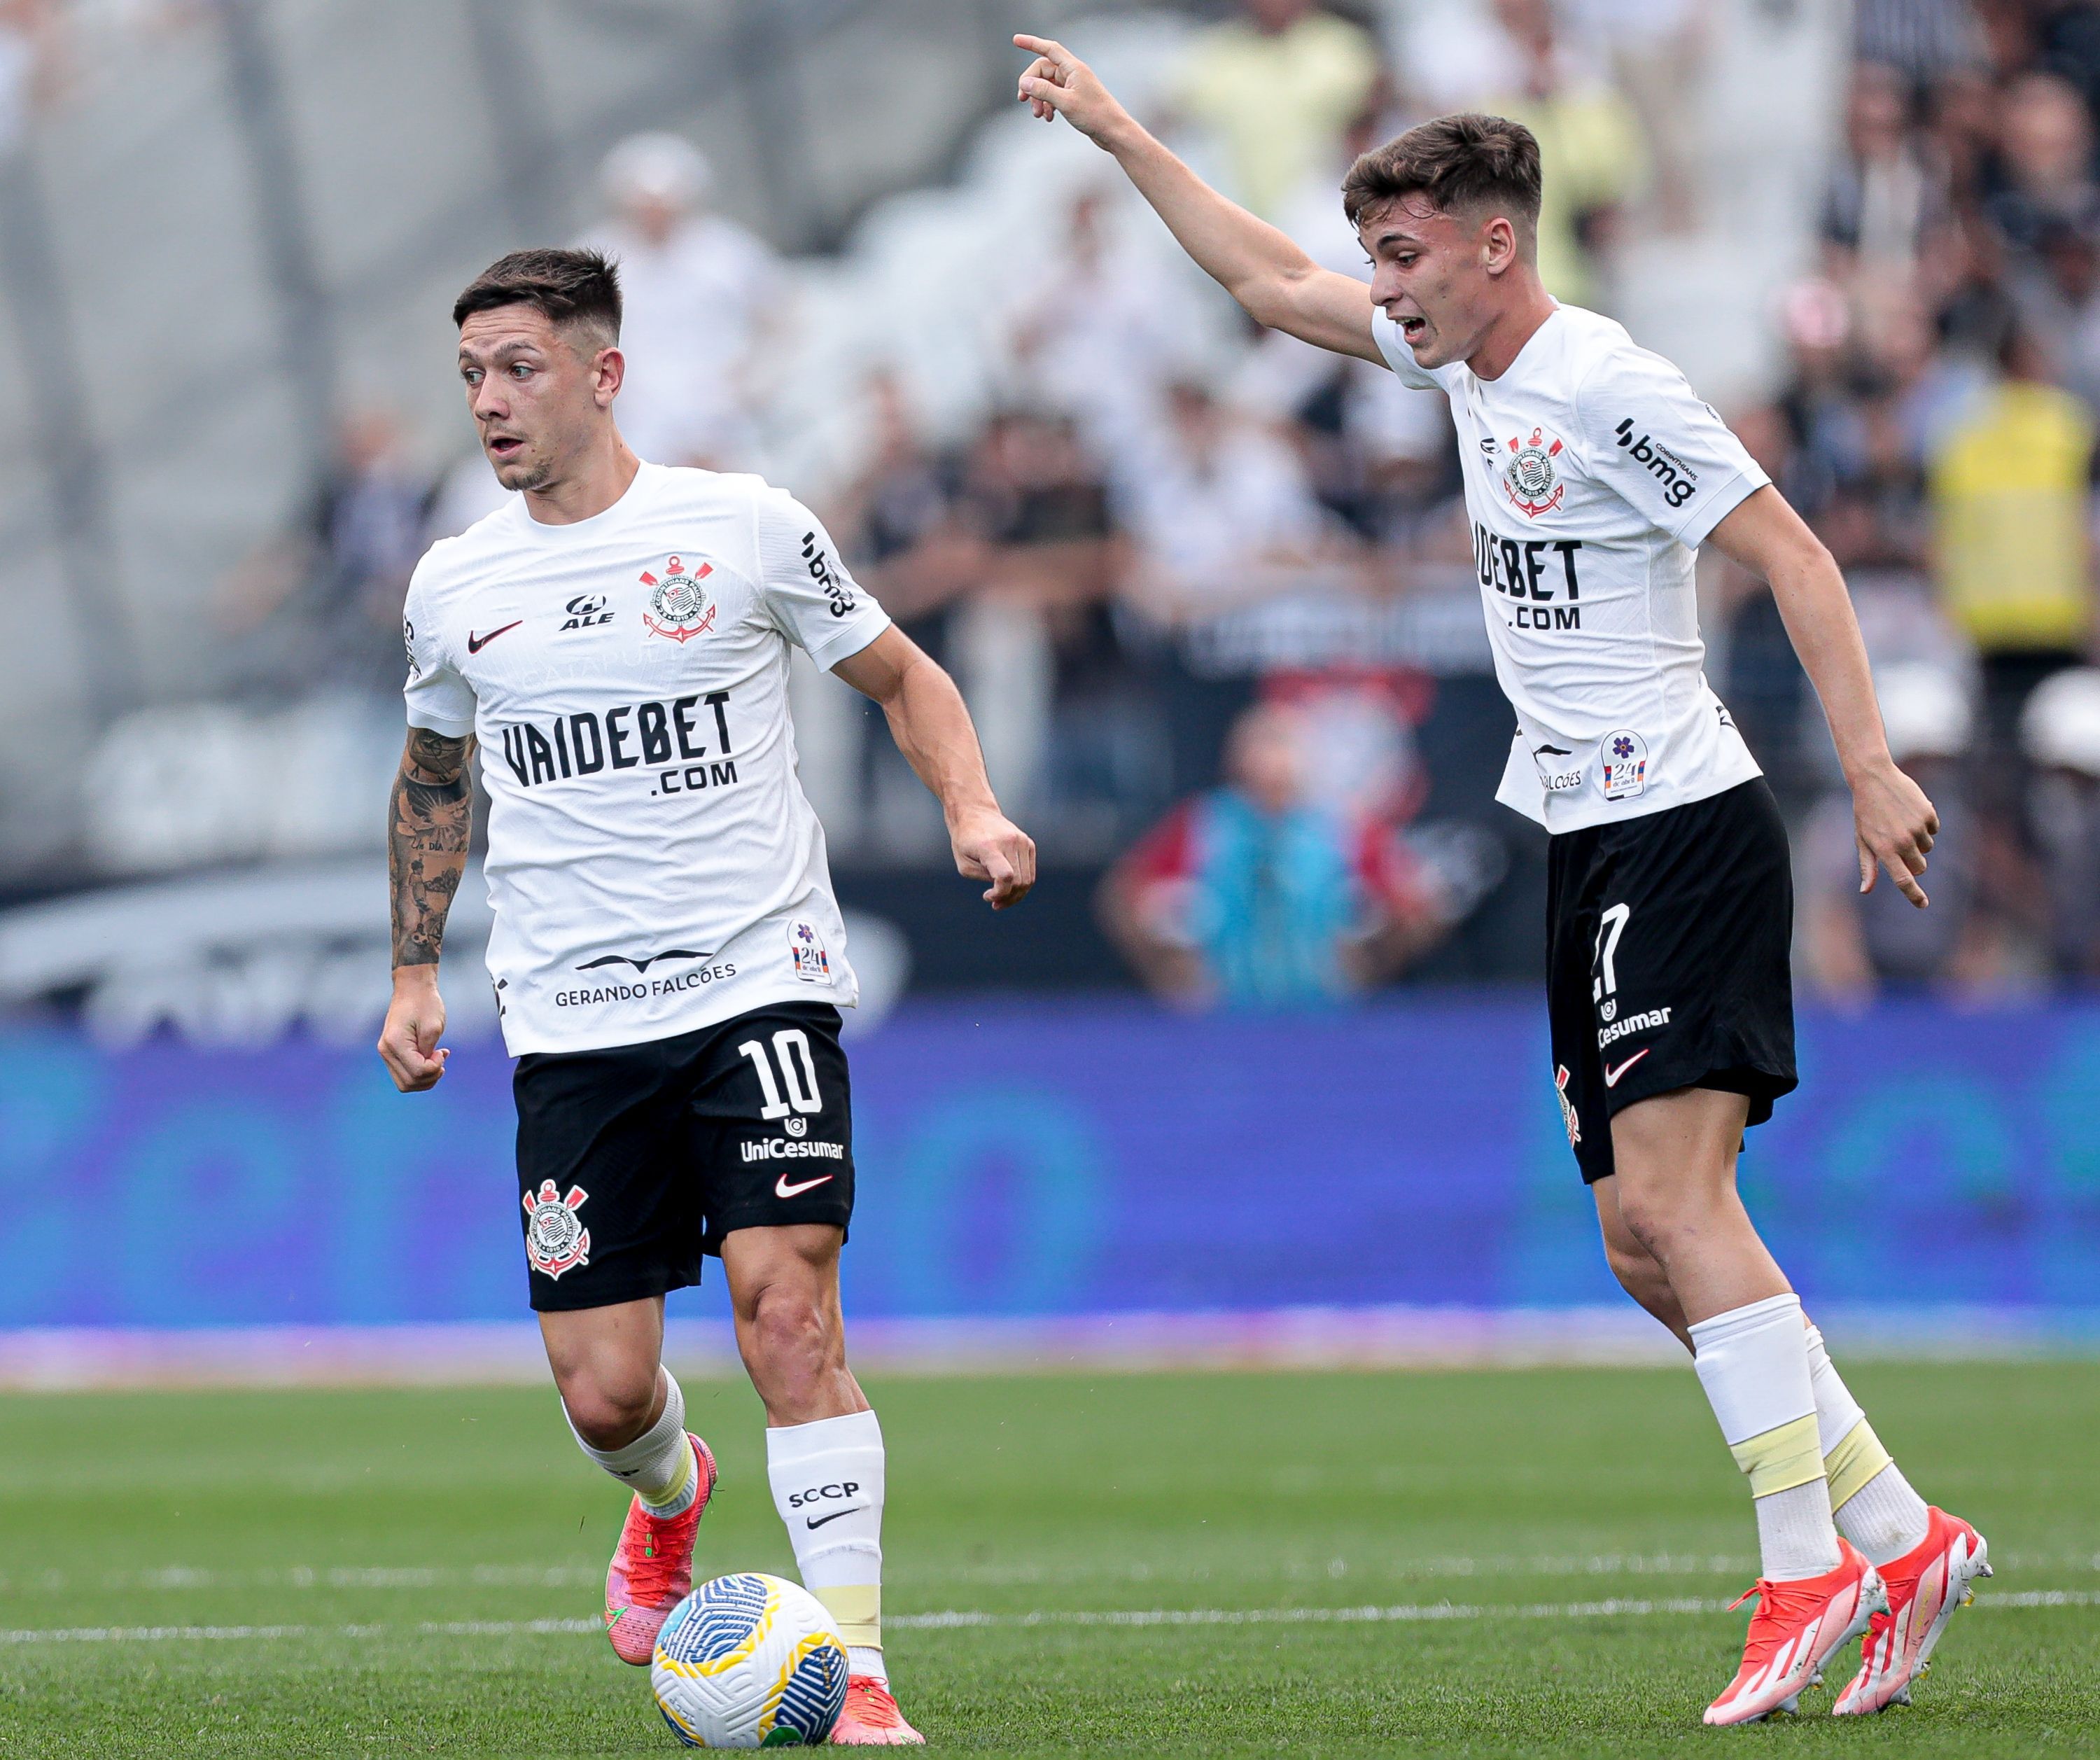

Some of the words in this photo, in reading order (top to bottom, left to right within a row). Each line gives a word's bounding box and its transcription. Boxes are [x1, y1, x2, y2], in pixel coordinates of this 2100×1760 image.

[1629, 435, 1695, 508] bmg
[1656, 443, 1698, 481] CORINTHIANS
[1470, 520, 1582, 601] IDEBET
[656, 579, 690, 606] CORINTHIANS
[690, 582, 701, 613] PAULISTA
[559, 612, 615, 631] ALE
[1508, 606, 1581, 630] .COM
[503, 692, 731, 788] VAIDEBET
[651, 761, 738, 796] .COM
[1614, 763, 1636, 780] 24
[802, 947, 820, 965] 24
[1590, 902, 1630, 1004] 7
[555, 982, 648, 1007] GERANDO
[652, 963, 737, 996] FALCÕES
[738, 1028, 823, 1120] 10
[741, 1138, 844, 1162] UniCesumar
[561, 1211, 573, 1243] PAULISTA
[789, 1481, 860, 1509] SCCP
